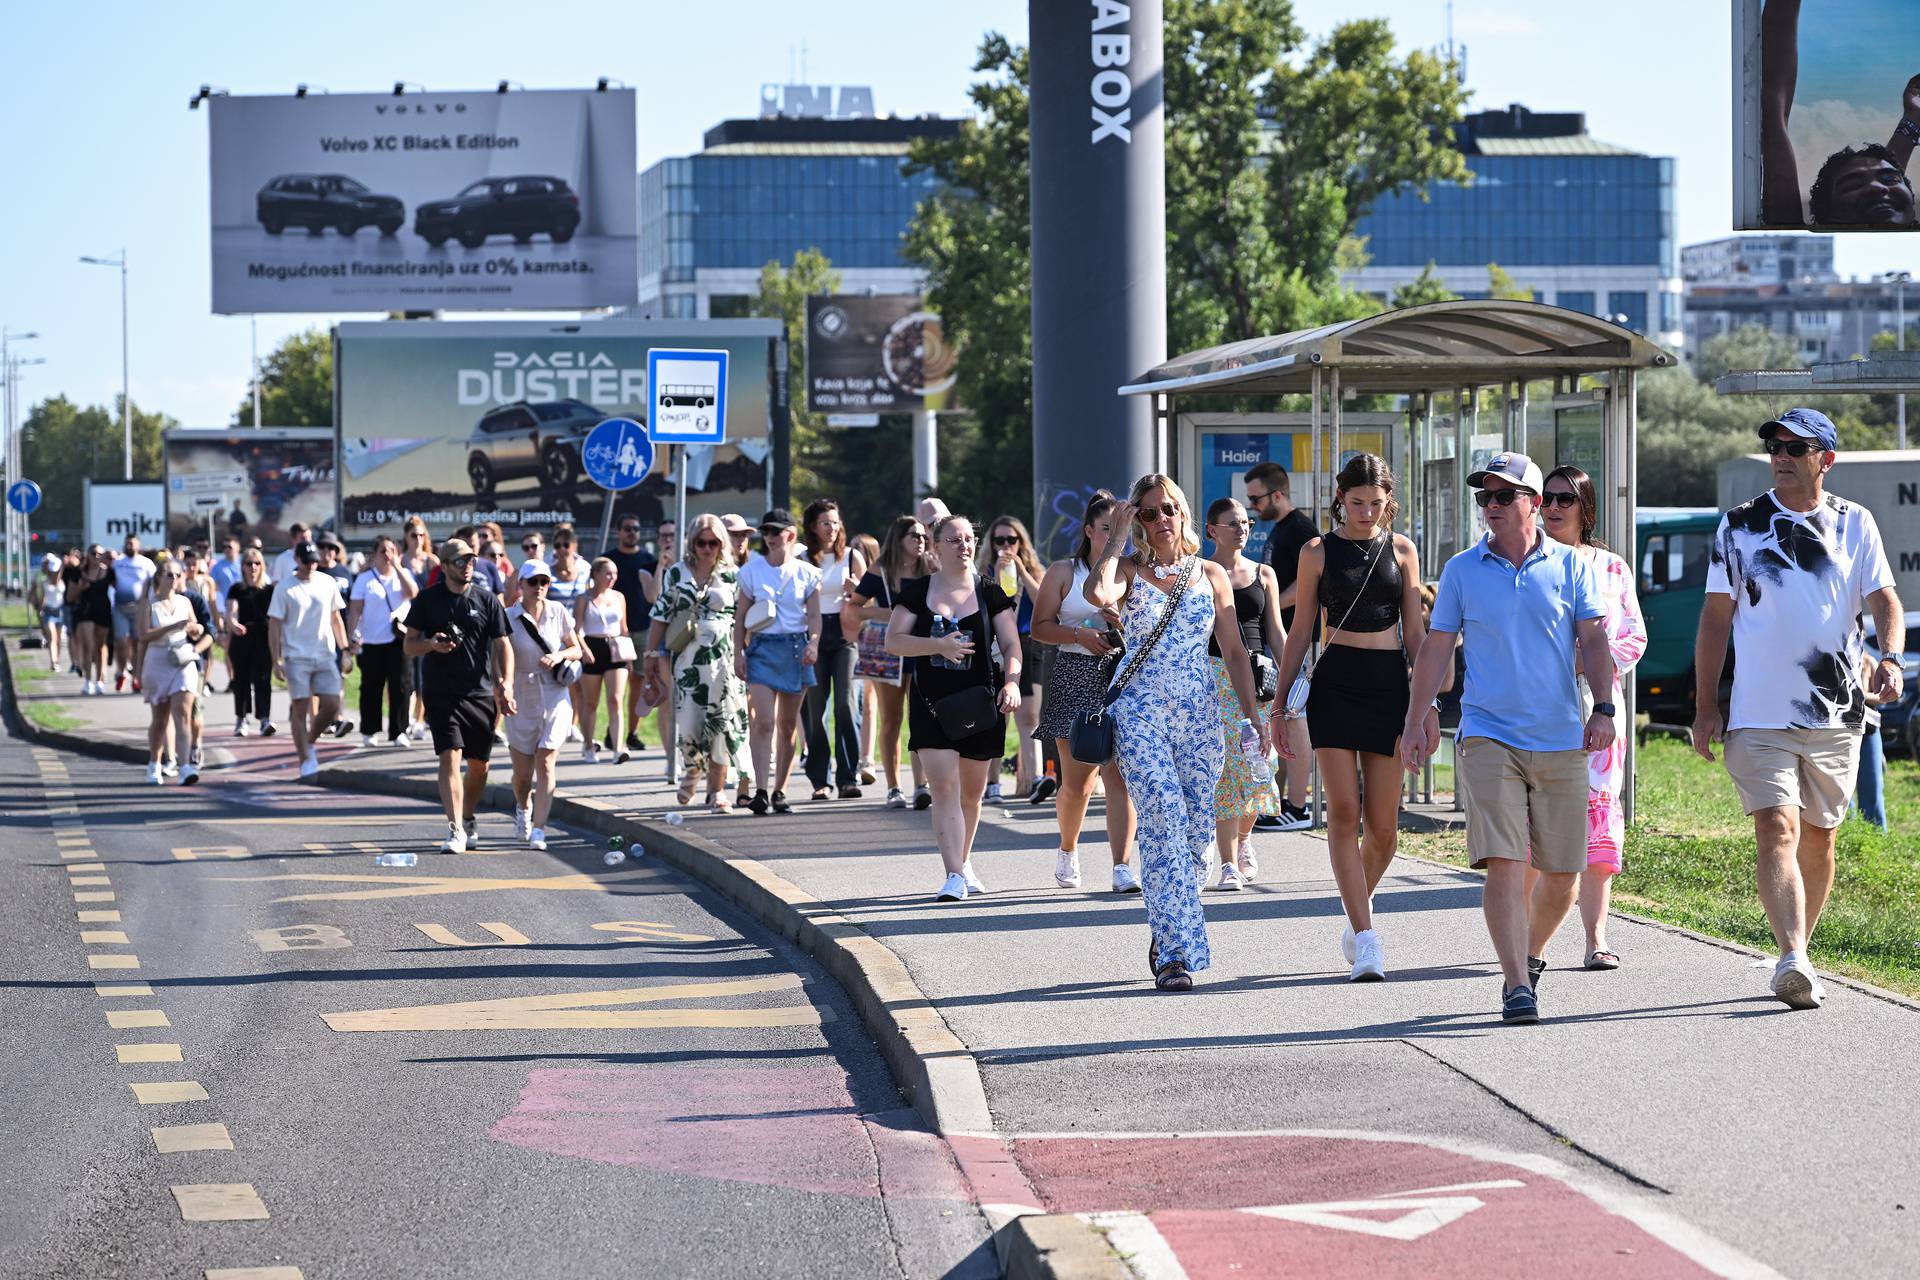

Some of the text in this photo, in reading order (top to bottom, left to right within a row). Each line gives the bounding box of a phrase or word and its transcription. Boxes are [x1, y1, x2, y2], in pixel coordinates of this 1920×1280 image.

[375, 103, 468, 115] VOLVO
[320, 134, 519, 152] Volvo XC Black Edition
[248, 258, 594, 281] Mogućnost financiranja uz 0% kamata.
[493, 352, 614, 367] DACIA
[457, 369, 647, 404] DUSTER
[1221, 450, 1262, 463] Haier
[1897, 482, 1920, 505] N
[357, 510, 374, 523] Uz
[375, 510, 386, 523] 0
[461, 511, 471, 522] 6
[471, 511, 518, 525] godina
[252, 920, 716, 952] BUS
